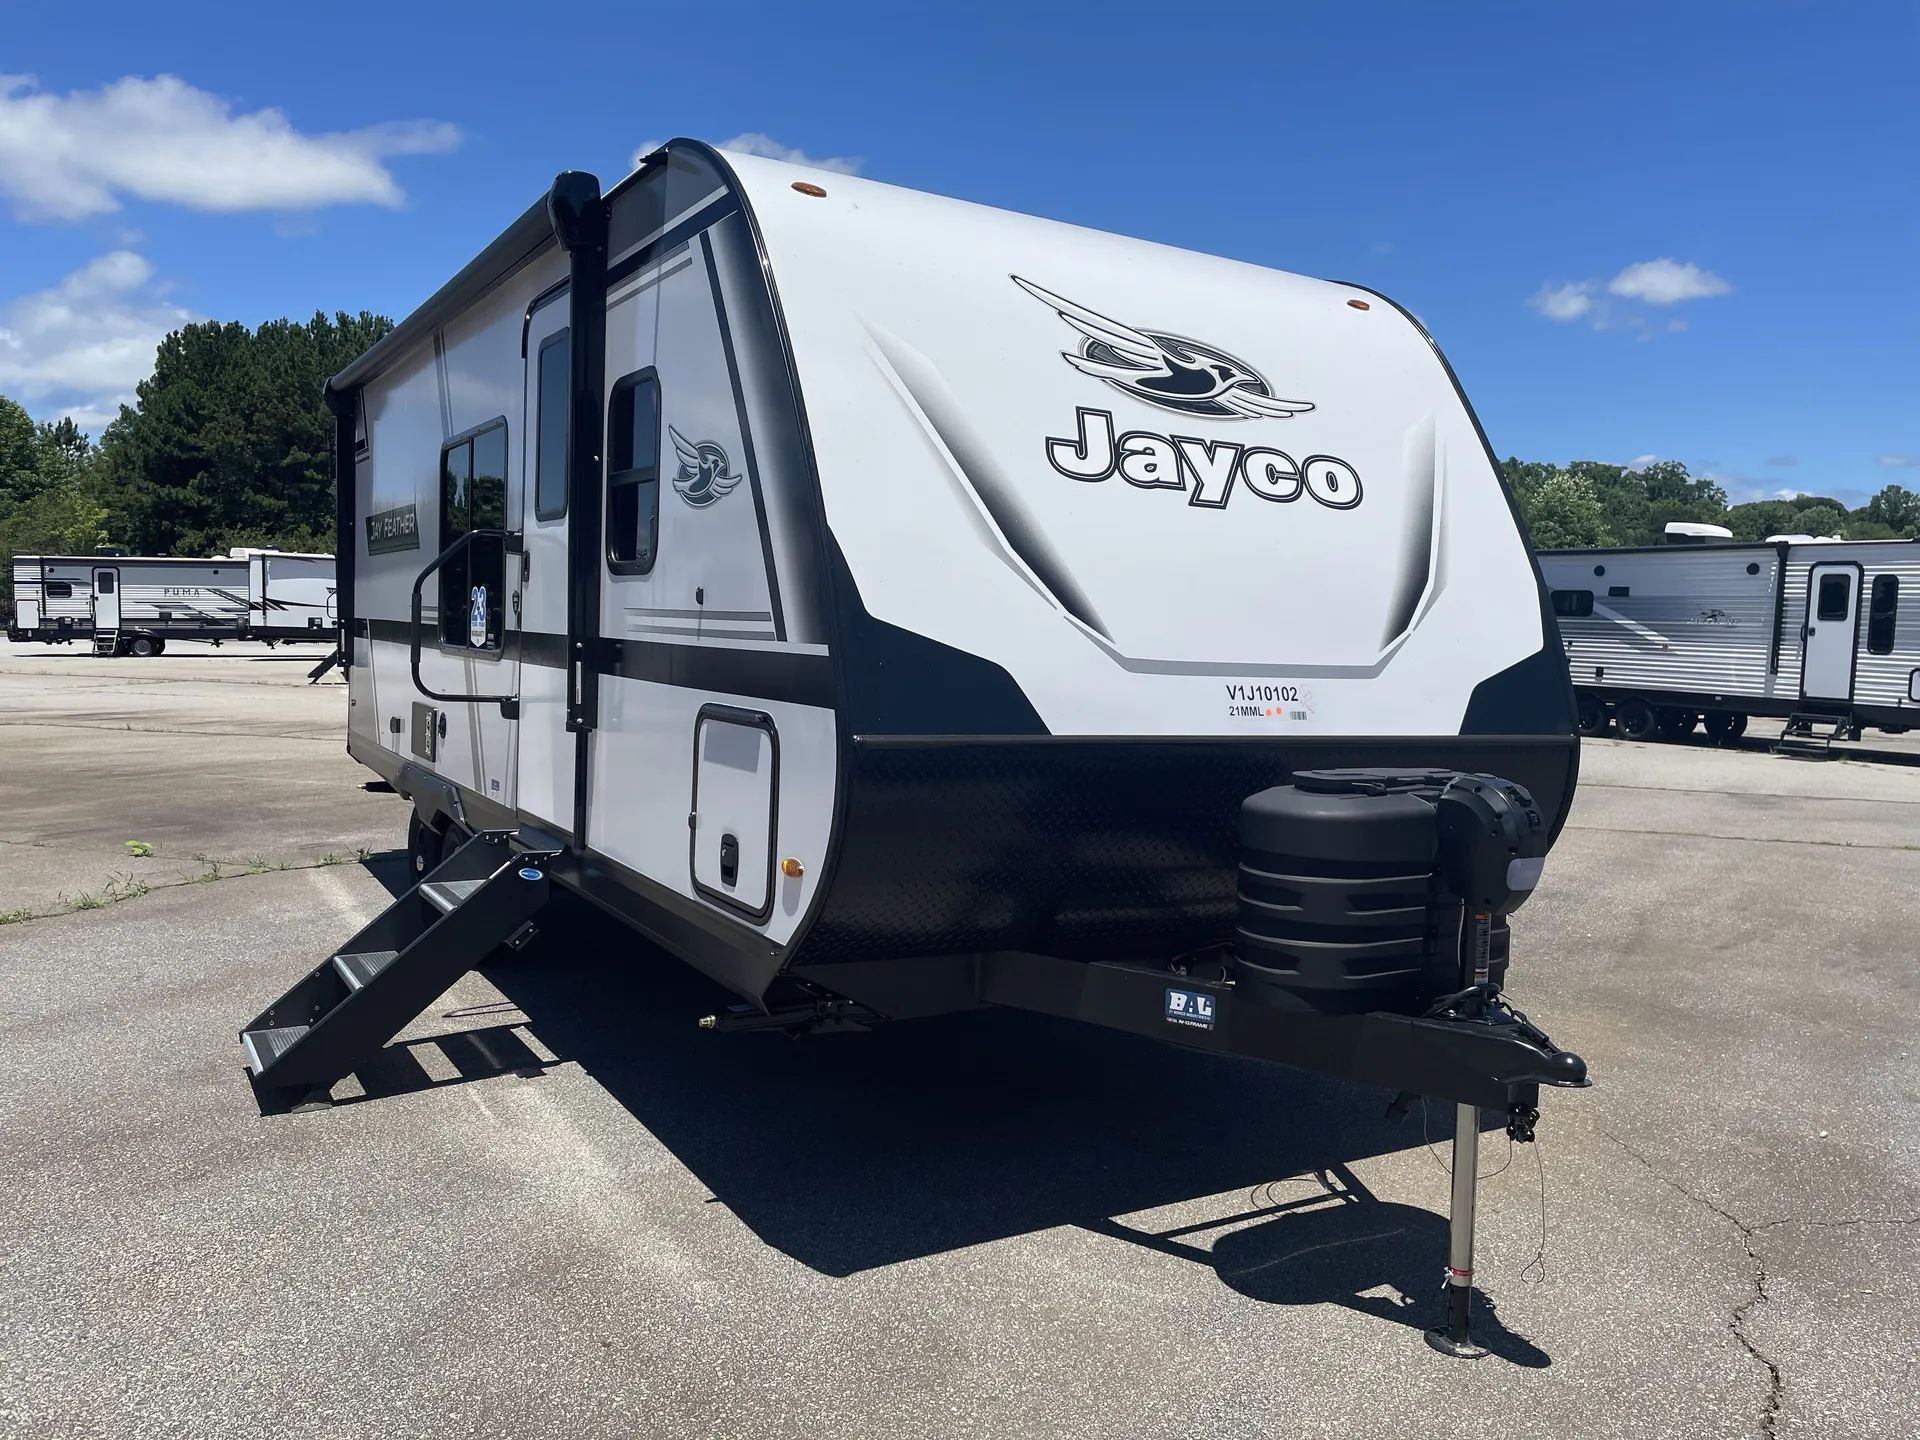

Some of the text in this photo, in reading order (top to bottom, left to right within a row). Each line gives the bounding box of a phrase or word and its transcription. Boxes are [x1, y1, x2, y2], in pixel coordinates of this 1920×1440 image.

[1045, 406, 1364, 511] Jayco
[371, 513, 415, 541] JAY FEATHER
[164, 588, 200, 596] PUMA
[1226, 684, 1299, 702] V1J10102
[1228, 705, 1265, 717] 21MML
[1169, 991, 1212, 1016] BAL
